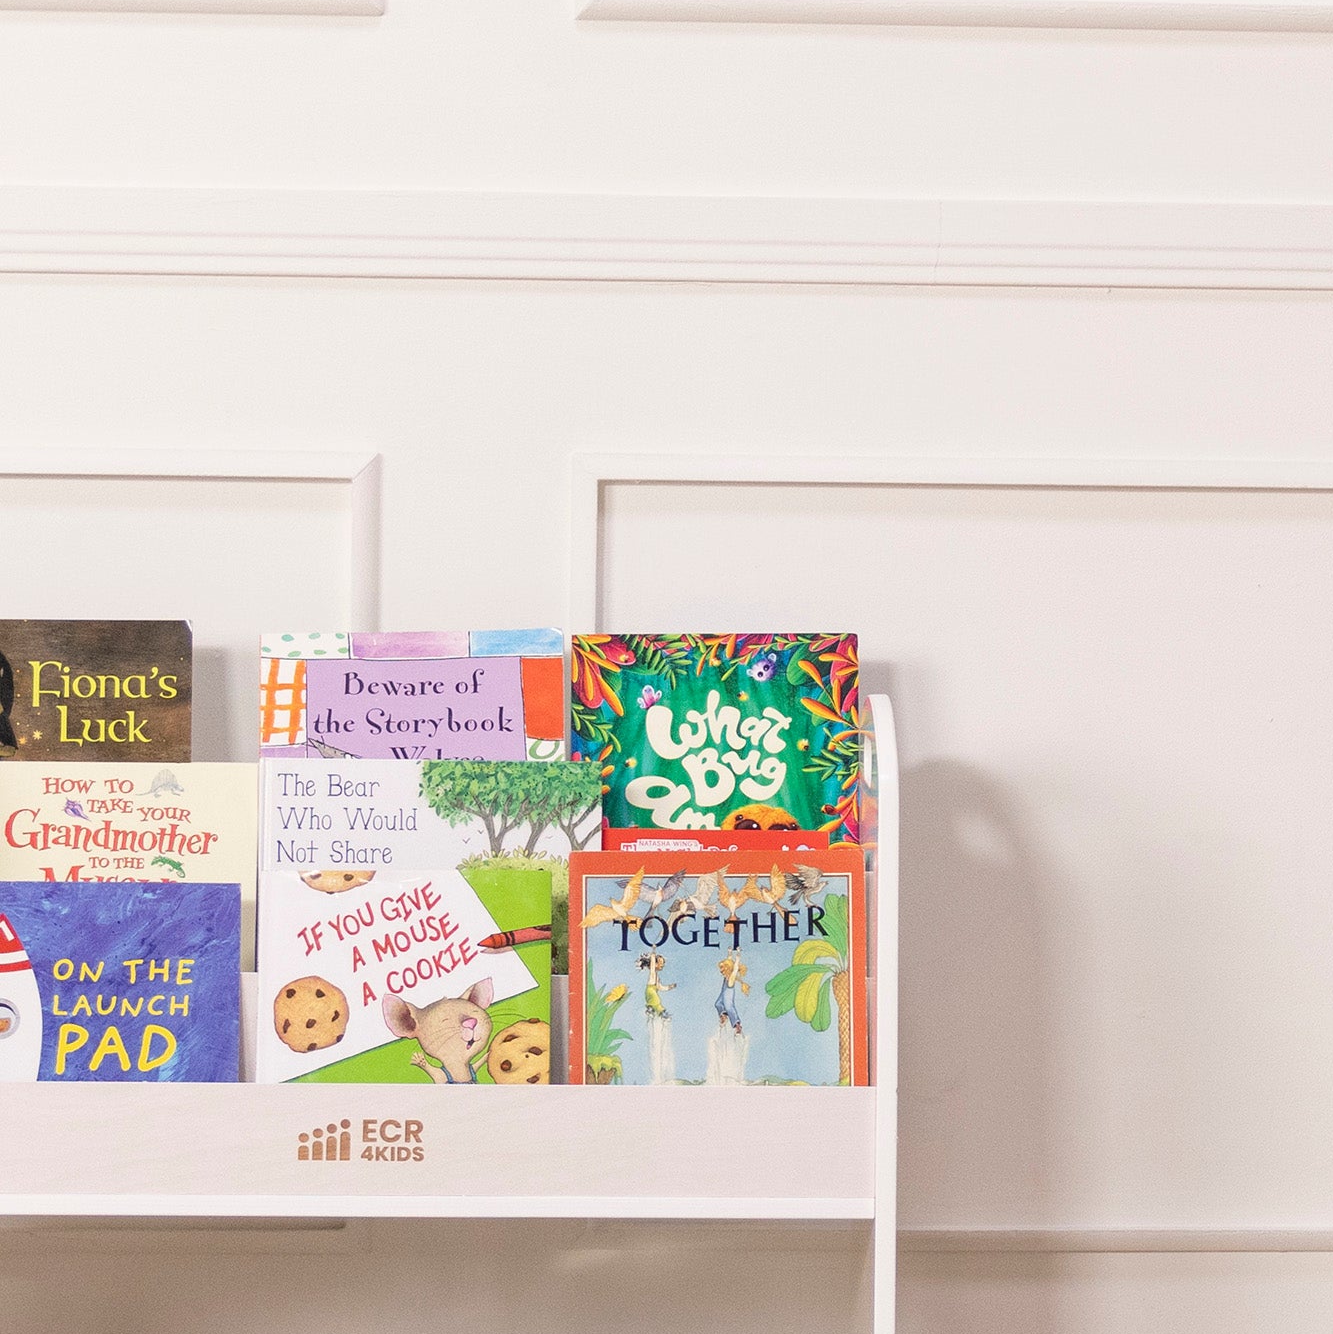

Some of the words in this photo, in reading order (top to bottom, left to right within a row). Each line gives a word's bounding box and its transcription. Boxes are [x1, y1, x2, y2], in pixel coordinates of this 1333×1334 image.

[29, 660, 178, 707] Fiona's
[343, 672, 444, 696] Beware
[455, 668, 485, 694] of
[56, 705, 151, 747] Luck
[313, 708, 355, 734] the
[365, 706, 514, 738] Storybook
[645, 689, 793, 760] What
[41, 777, 96, 795] HOW
[104, 778, 135, 794] TO
[277, 773, 317, 798] The
[327, 773, 380, 798] Bear
[682, 747, 787, 807] Bug
[87, 798, 134, 814] TAKE
[136, 807, 192, 824] YOUR
[277, 806, 333, 830] Who
[344, 807, 418, 832] Would
[4, 808, 219, 856] Grandmother
[638, 839, 672, 848] NATASHA
[88, 857, 110, 869] TO
[113, 857, 145, 869] THE
[276, 840, 319, 864] Not
[330, 839, 393, 864] Share
[297, 921, 324, 956] IF
[328, 902, 374, 941] YOU
[380, 881, 442, 922] GIVE
[612, 905, 829, 951] TOGETHER
[352, 945, 366, 972] A
[371, 912, 459, 963] MOUSE
[53, 958, 104, 982] ON
[123, 958, 195, 985] THE
[363, 981, 377, 1006] A
[385, 937, 480, 995] COOKIE
[53, 995, 189, 1017] LAUNCH
[55, 1023, 177, 1076] PAD
[361, 1119, 424, 1143] ECR
[360, 1146, 424, 1162] 4KIDS
